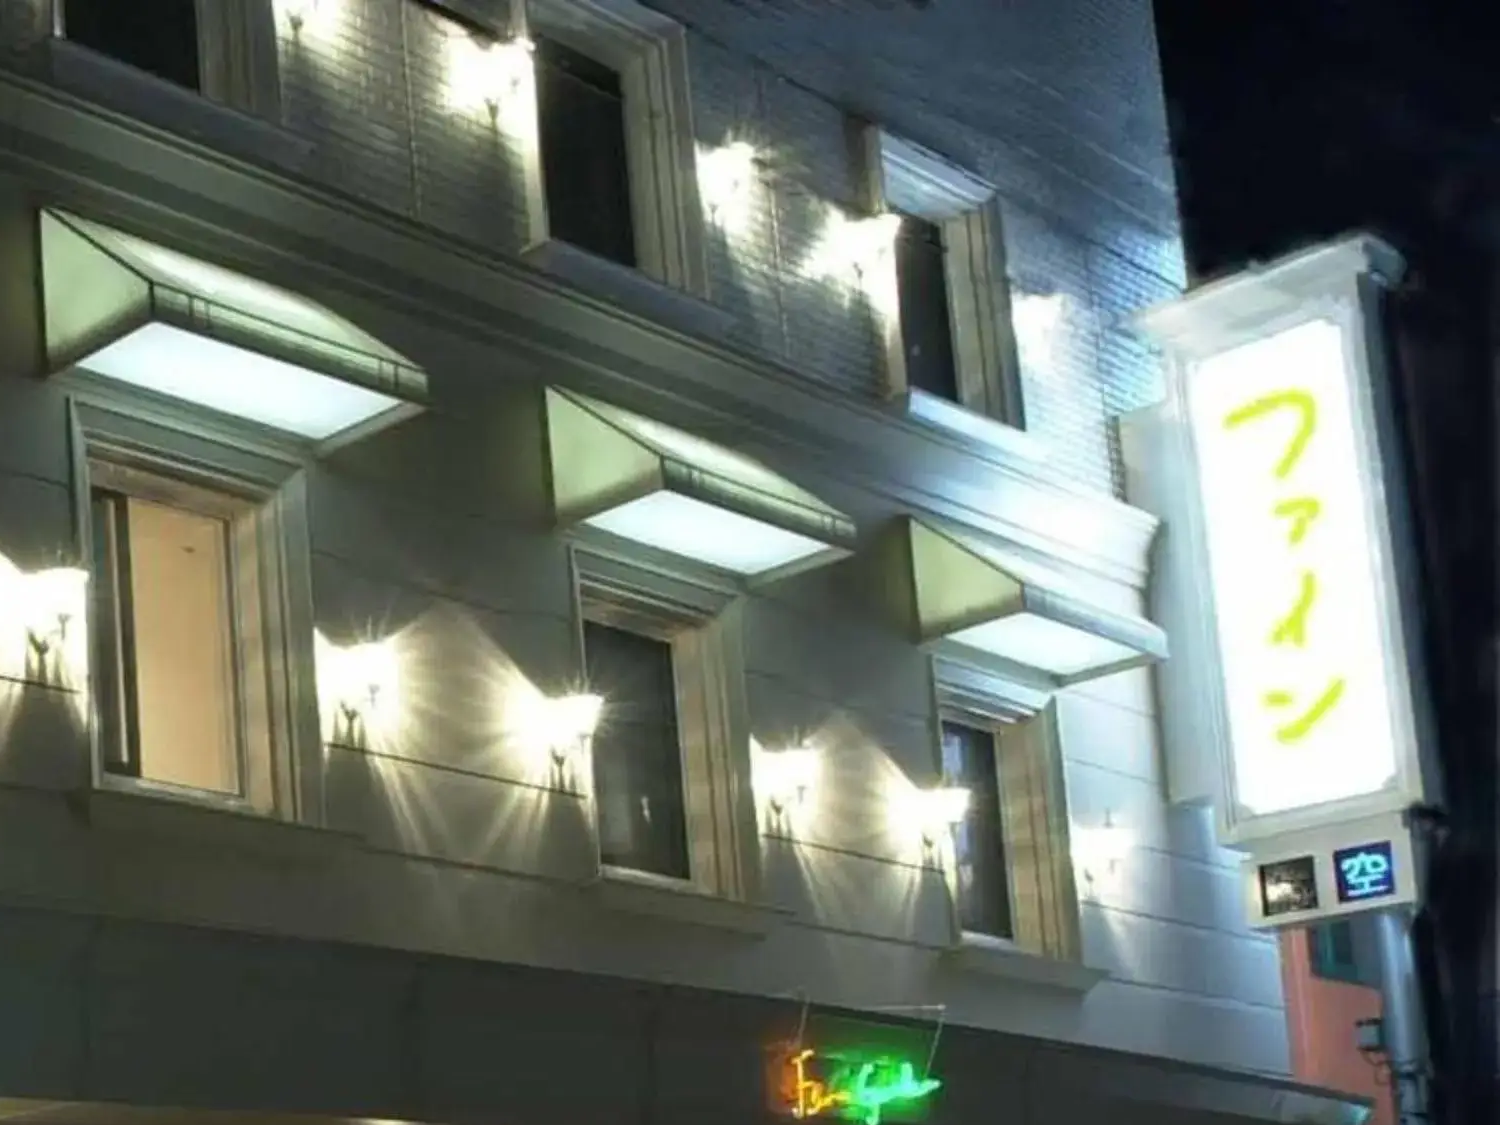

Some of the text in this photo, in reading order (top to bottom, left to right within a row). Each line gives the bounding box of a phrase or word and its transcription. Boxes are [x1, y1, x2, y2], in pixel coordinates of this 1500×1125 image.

[1221, 386, 1349, 746] ファイン
[1340, 850, 1390, 897] 空
